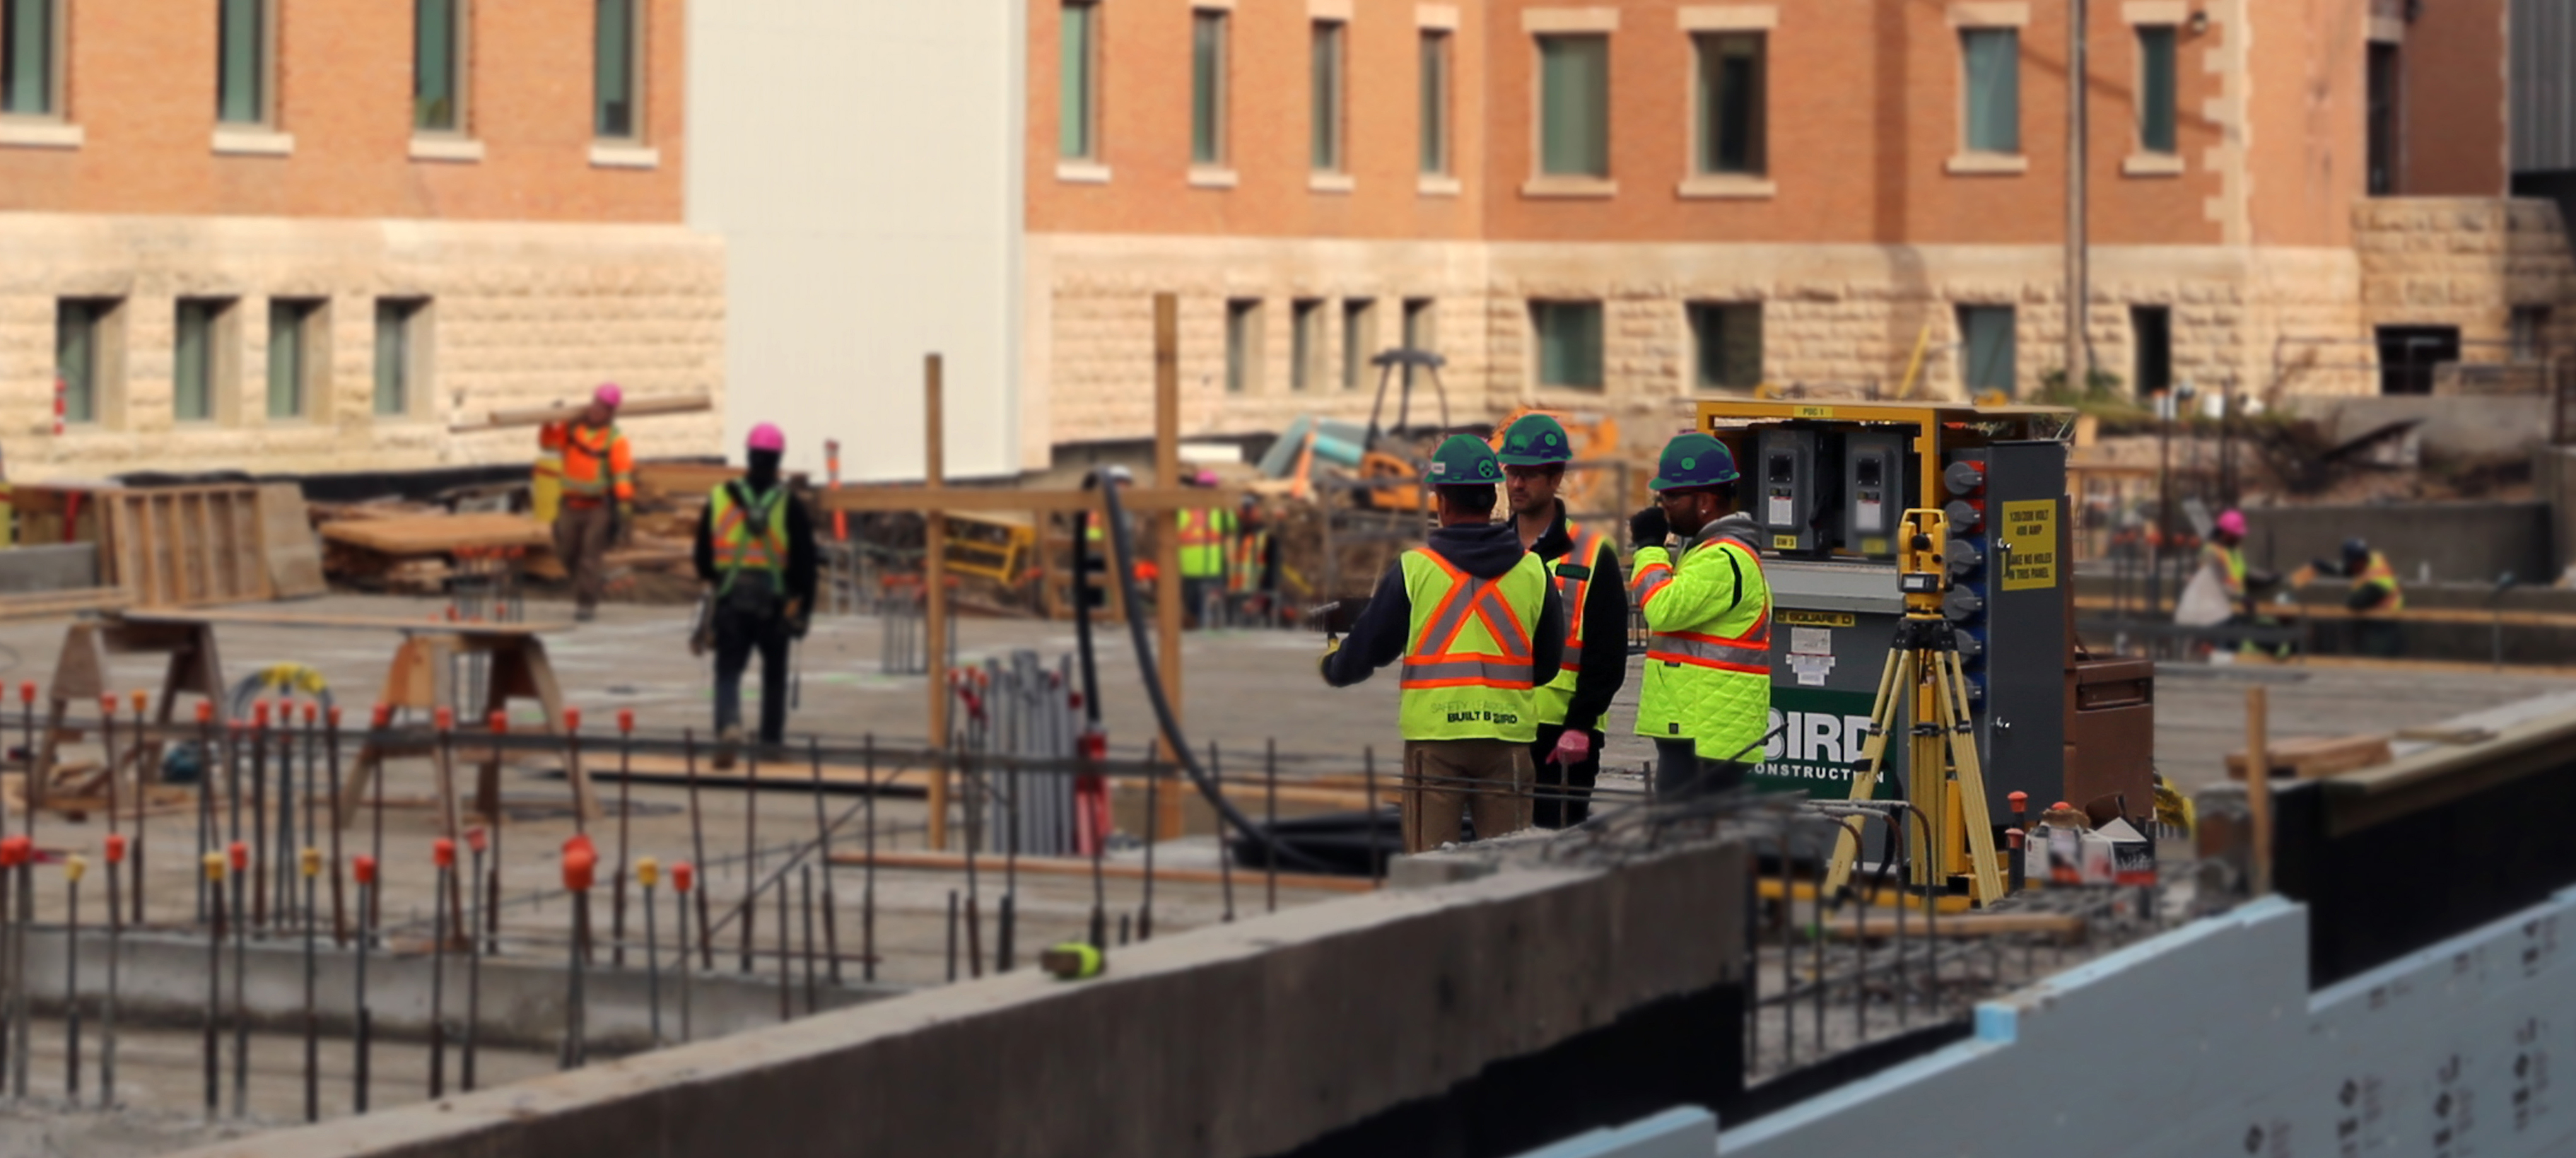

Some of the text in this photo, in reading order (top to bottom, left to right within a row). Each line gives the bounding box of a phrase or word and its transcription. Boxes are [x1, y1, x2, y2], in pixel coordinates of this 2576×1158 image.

[2029, 524, 2042, 535] AMP
[2010, 553, 2052, 565] AKE NO HOLES
[1789, 611, 1853, 624] SQUARE D
[1448, 711, 1480, 723] BUILT
[1747, 763, 1884, 783] ONSTRUCTN
